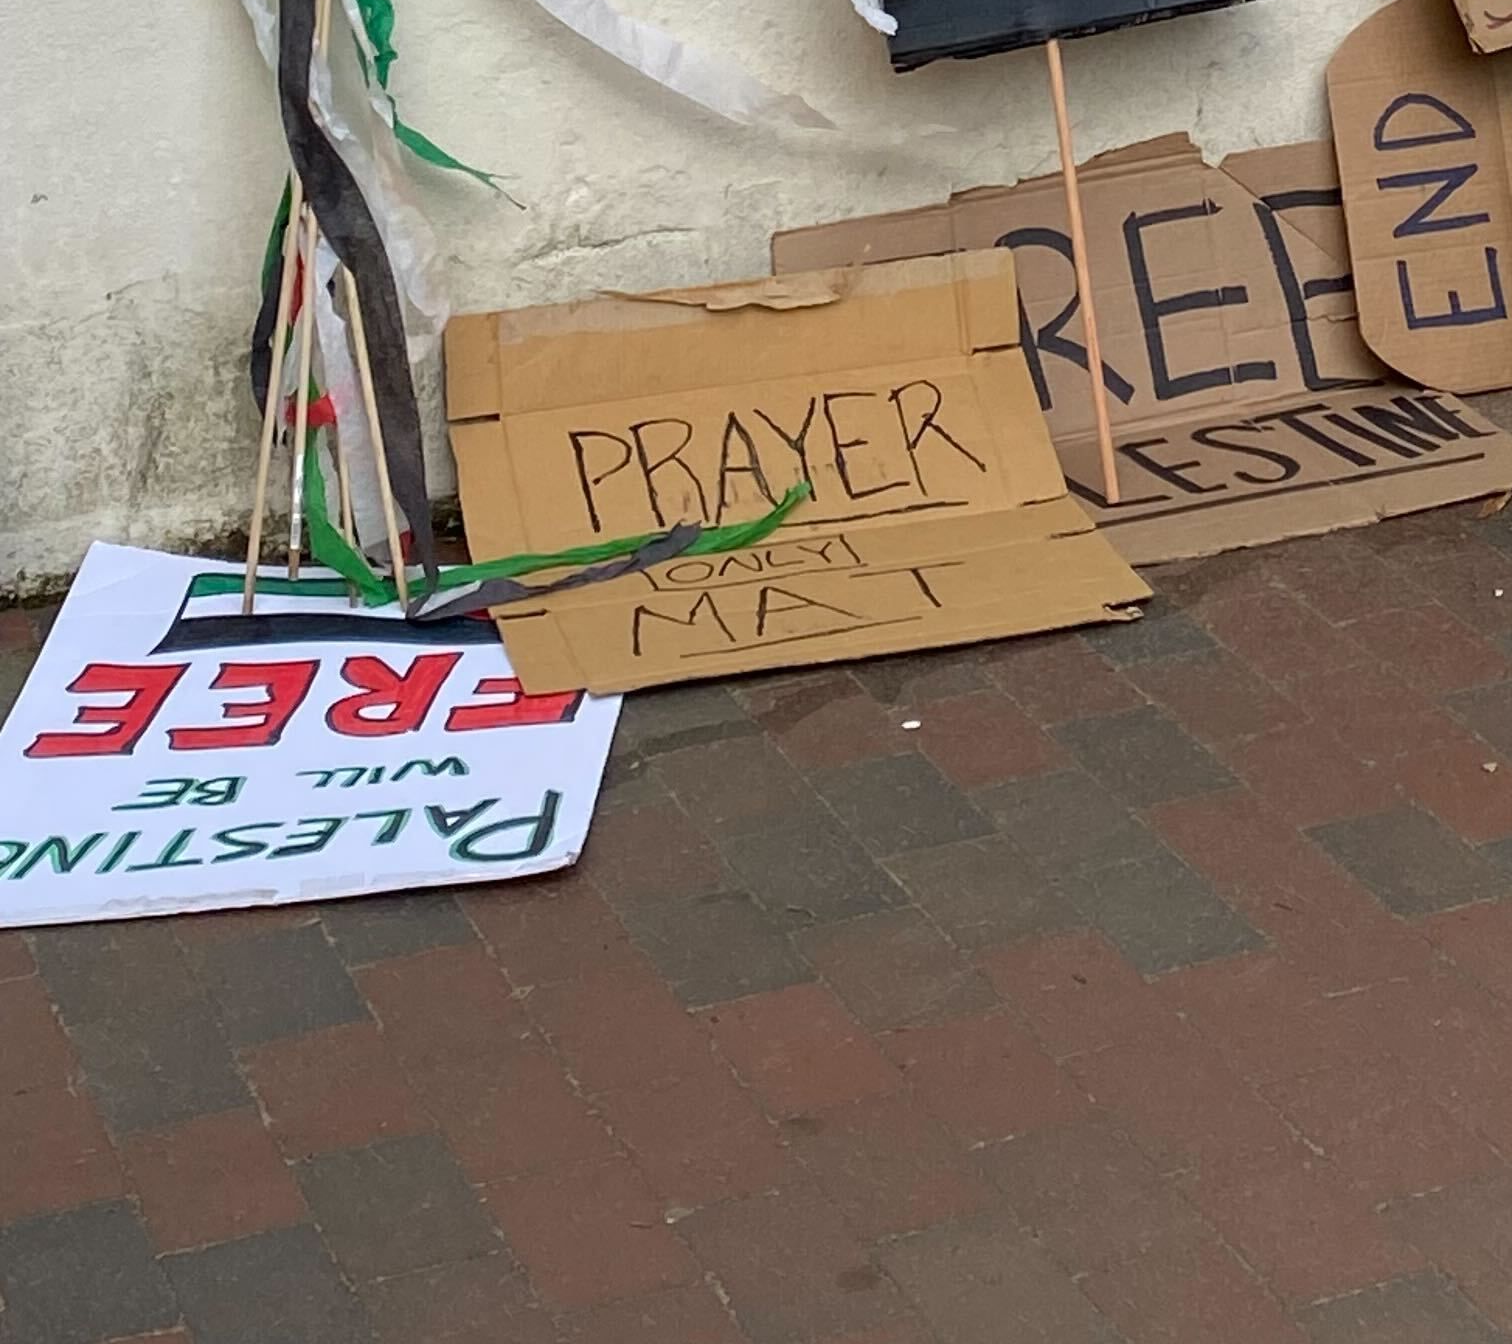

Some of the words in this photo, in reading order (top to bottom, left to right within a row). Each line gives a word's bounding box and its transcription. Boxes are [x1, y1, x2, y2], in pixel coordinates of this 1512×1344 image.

[1374, 92, 1507, 329] END
[862, 188, 1385, 410] REE
[569, 379, 986, 532] PRAYER
[1064, 396, 1498, 507] LESTINE
[633, 562, 966, 656] MAT
[23, 652, 583, 758] FREE
[111, 775, 248, 811] BE
[296, 756, 470, 789] WILL
